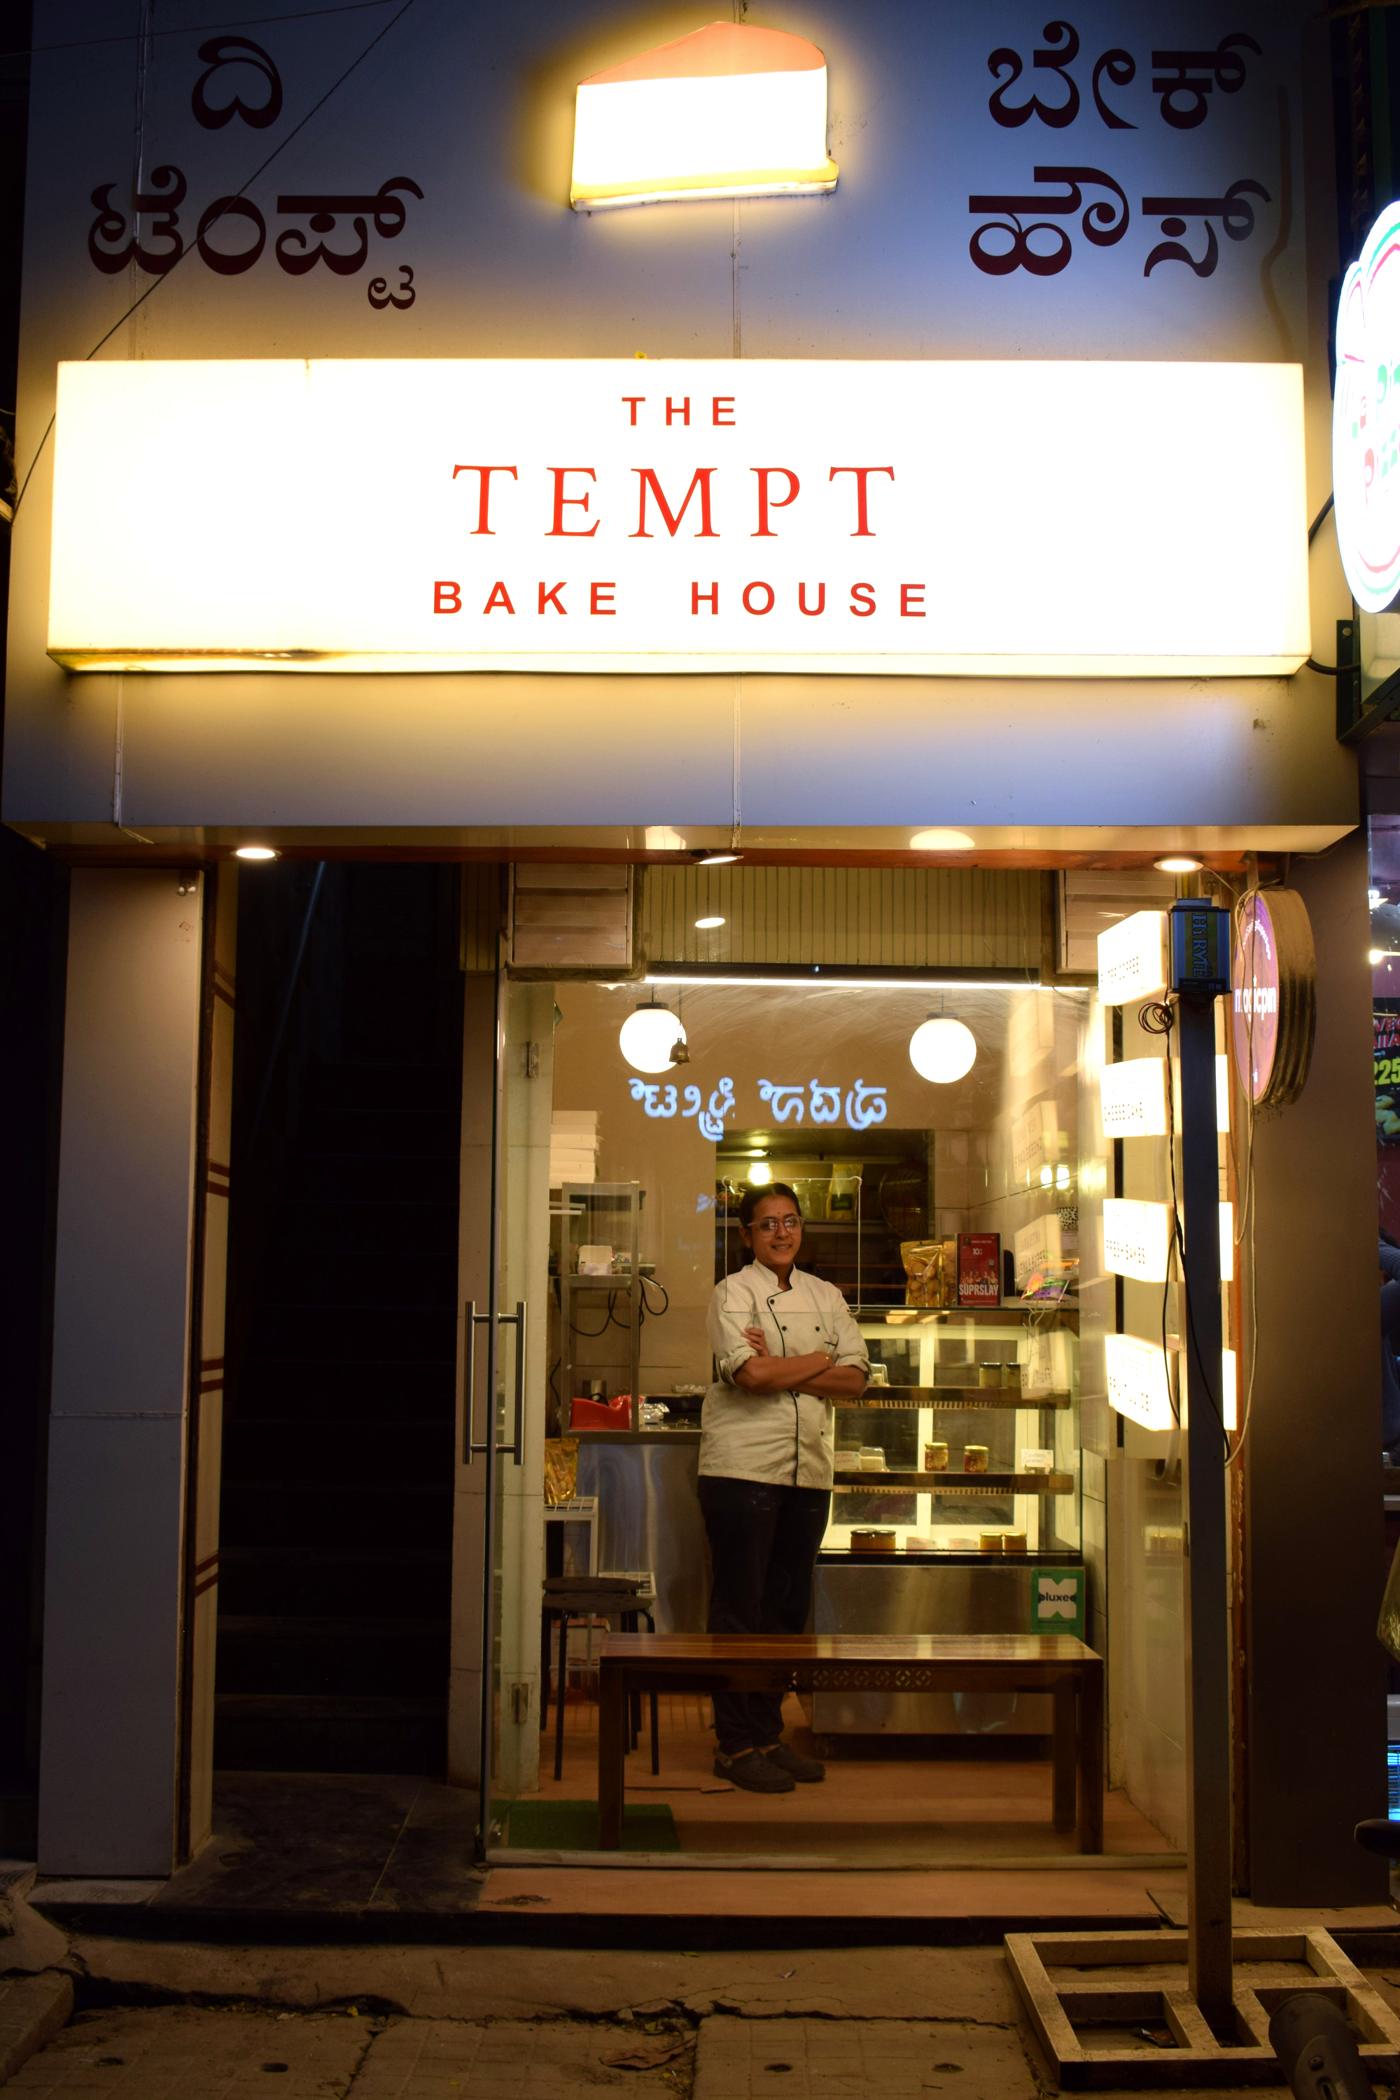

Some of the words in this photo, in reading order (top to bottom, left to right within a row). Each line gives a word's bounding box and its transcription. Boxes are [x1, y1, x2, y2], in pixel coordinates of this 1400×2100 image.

[191, 36, 284, 130] ದಿ
[988, 20, 1262, 130] ಬೇಕ್
[968, 165, 1271, 278] ಹೌಸ್
[621, 396, 737, 426] THE
[452, 464, 895, 538] TEMPT
[433, 580, 617, 615] BAKE
[690, 581, 927, 618] HOUSE
